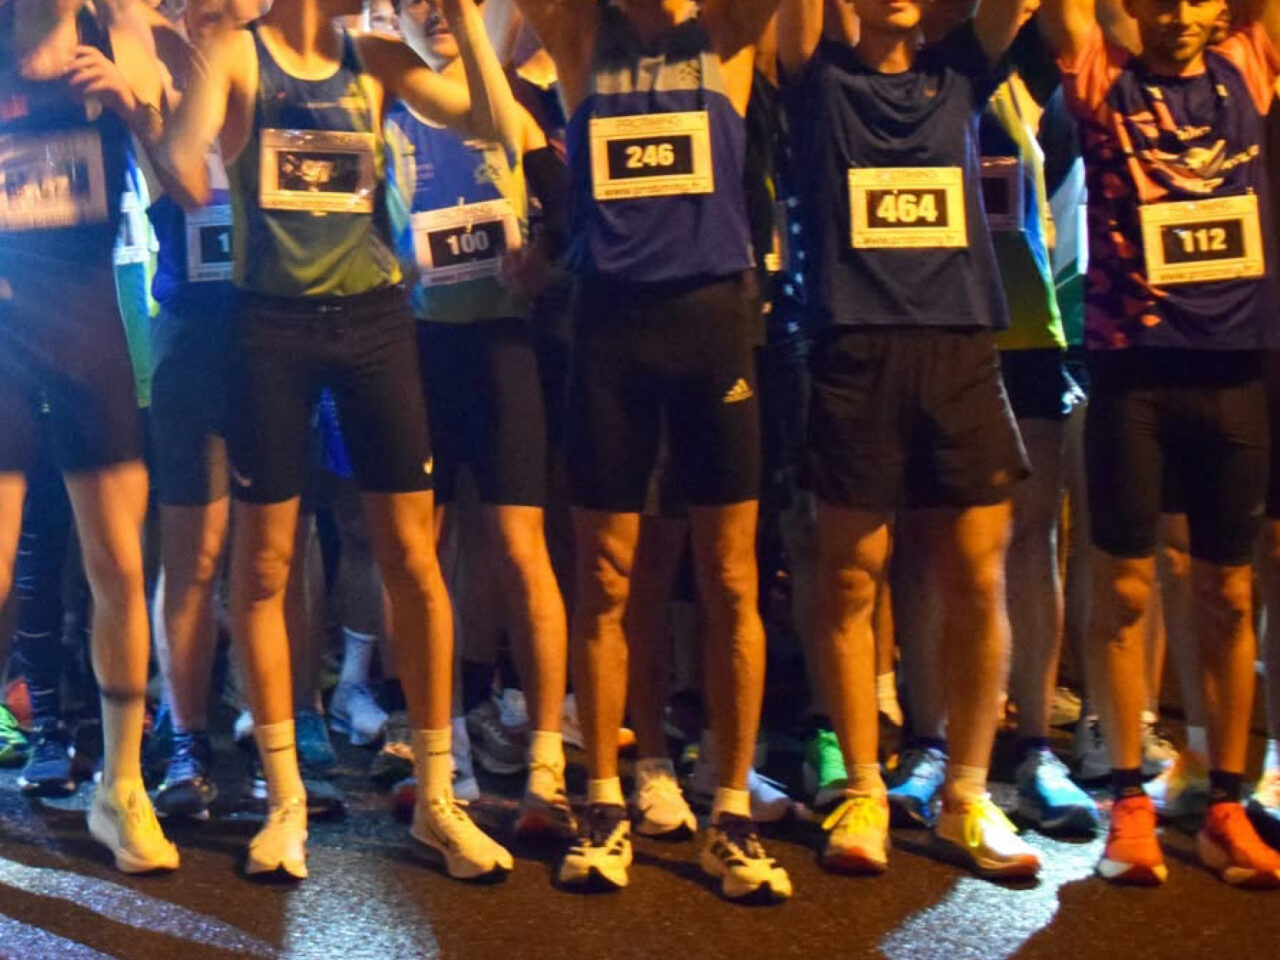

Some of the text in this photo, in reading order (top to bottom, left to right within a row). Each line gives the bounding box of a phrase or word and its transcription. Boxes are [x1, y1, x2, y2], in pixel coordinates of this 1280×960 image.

[625, 143, 675, 169] 246
[876, 193, 938, 223] 464
[445, 230, 489, 256] 100
[1179, 227, 1228, 253] 112
